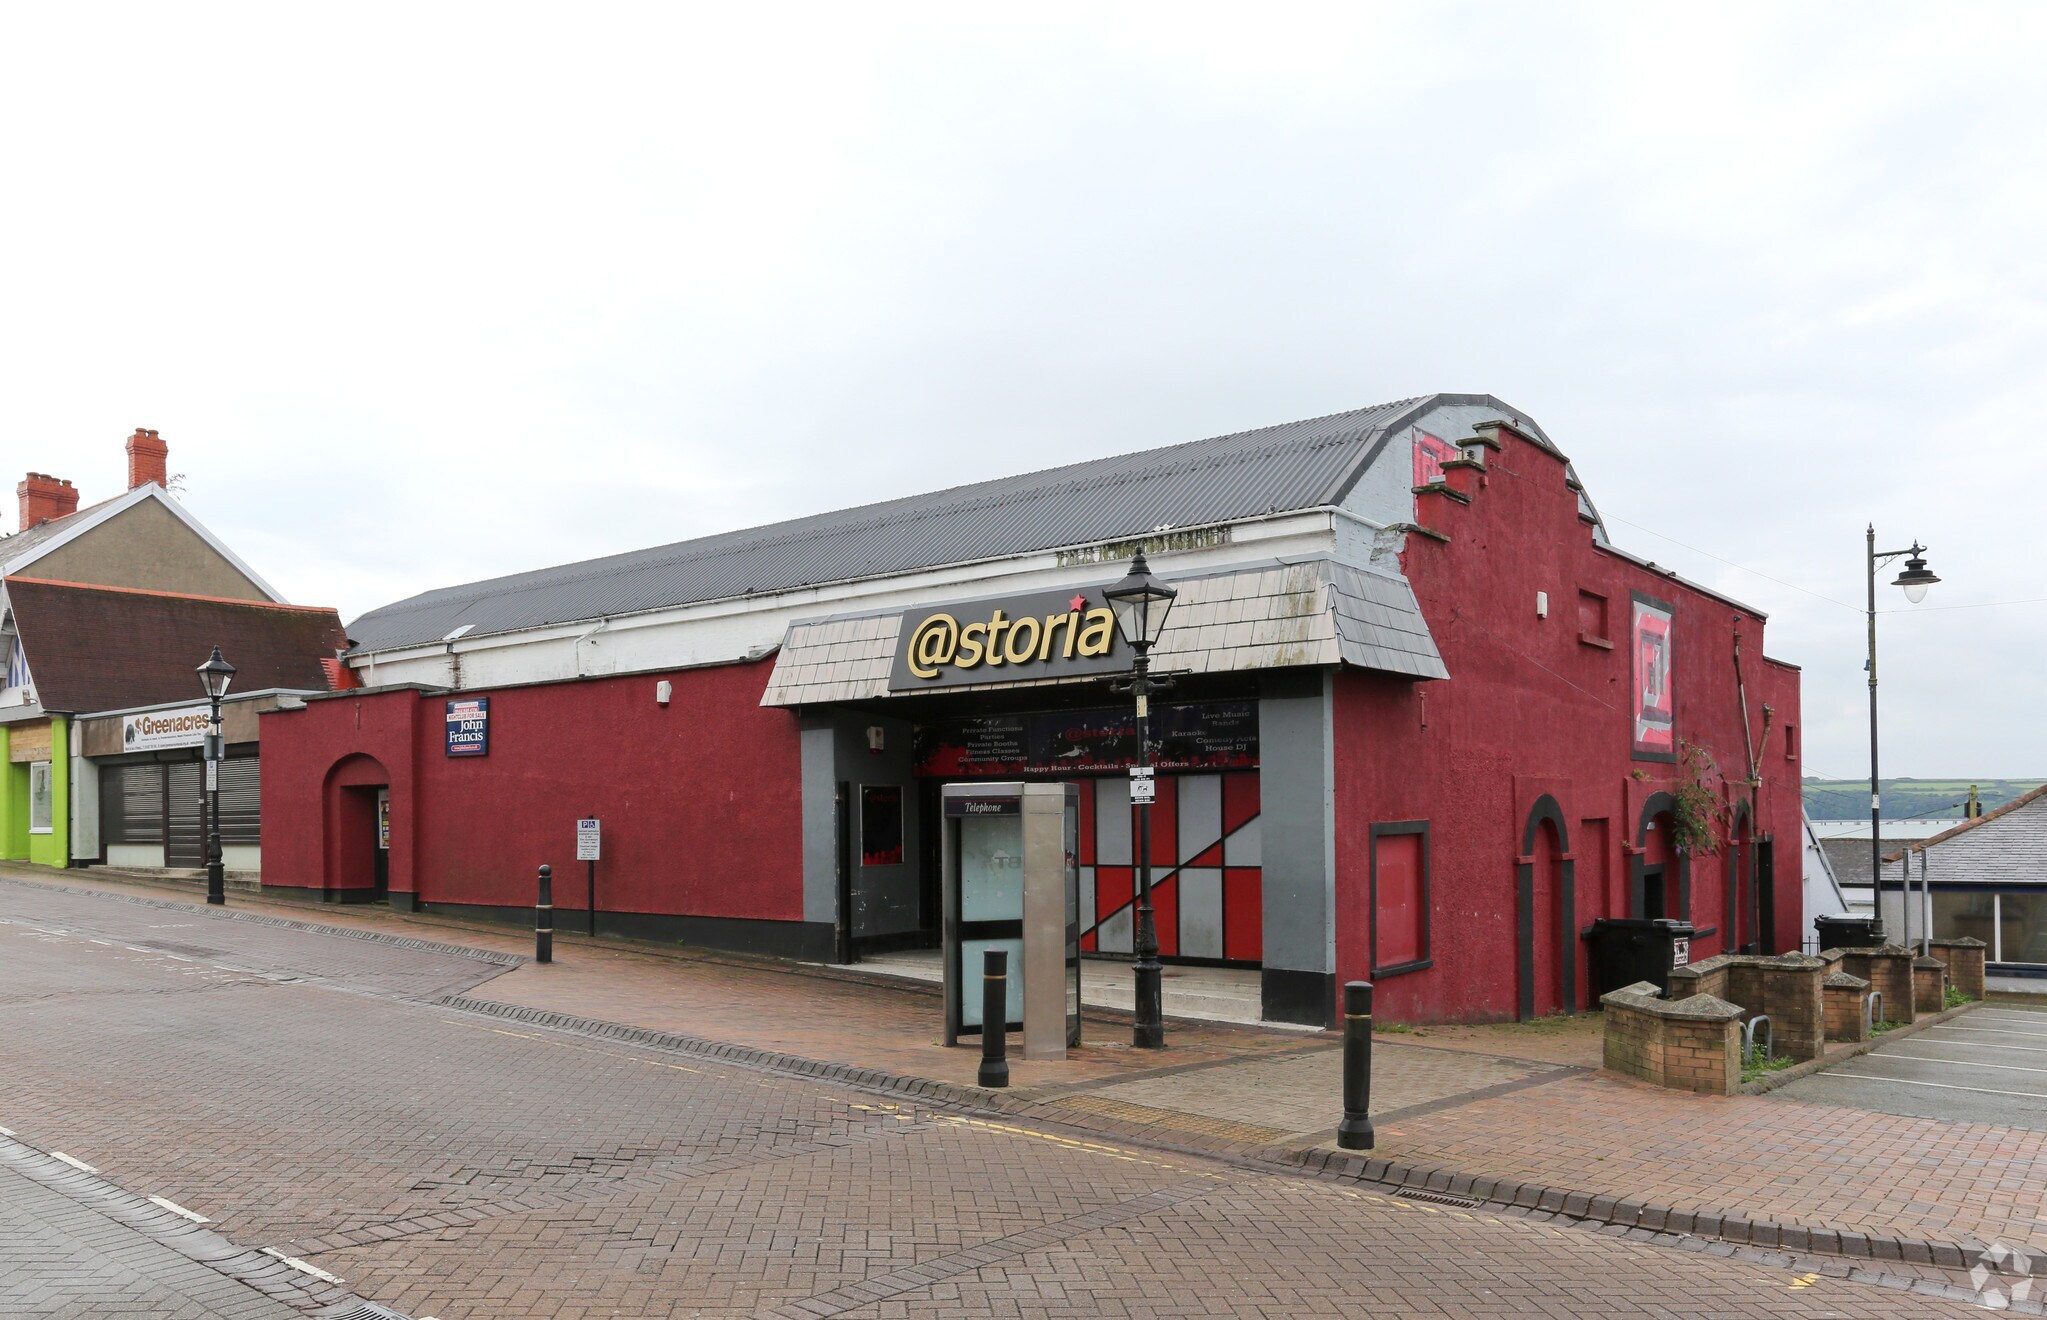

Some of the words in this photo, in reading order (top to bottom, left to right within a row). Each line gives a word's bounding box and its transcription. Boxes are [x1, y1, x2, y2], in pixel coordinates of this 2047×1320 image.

[908, 595, 1117, 679] @storia
[142, 713, 209, 735] Greenacres
[460, 720, 484, 732] John
[449, 729, 484, 742] Francis
[964, 802, 1002, 814] Telephone
